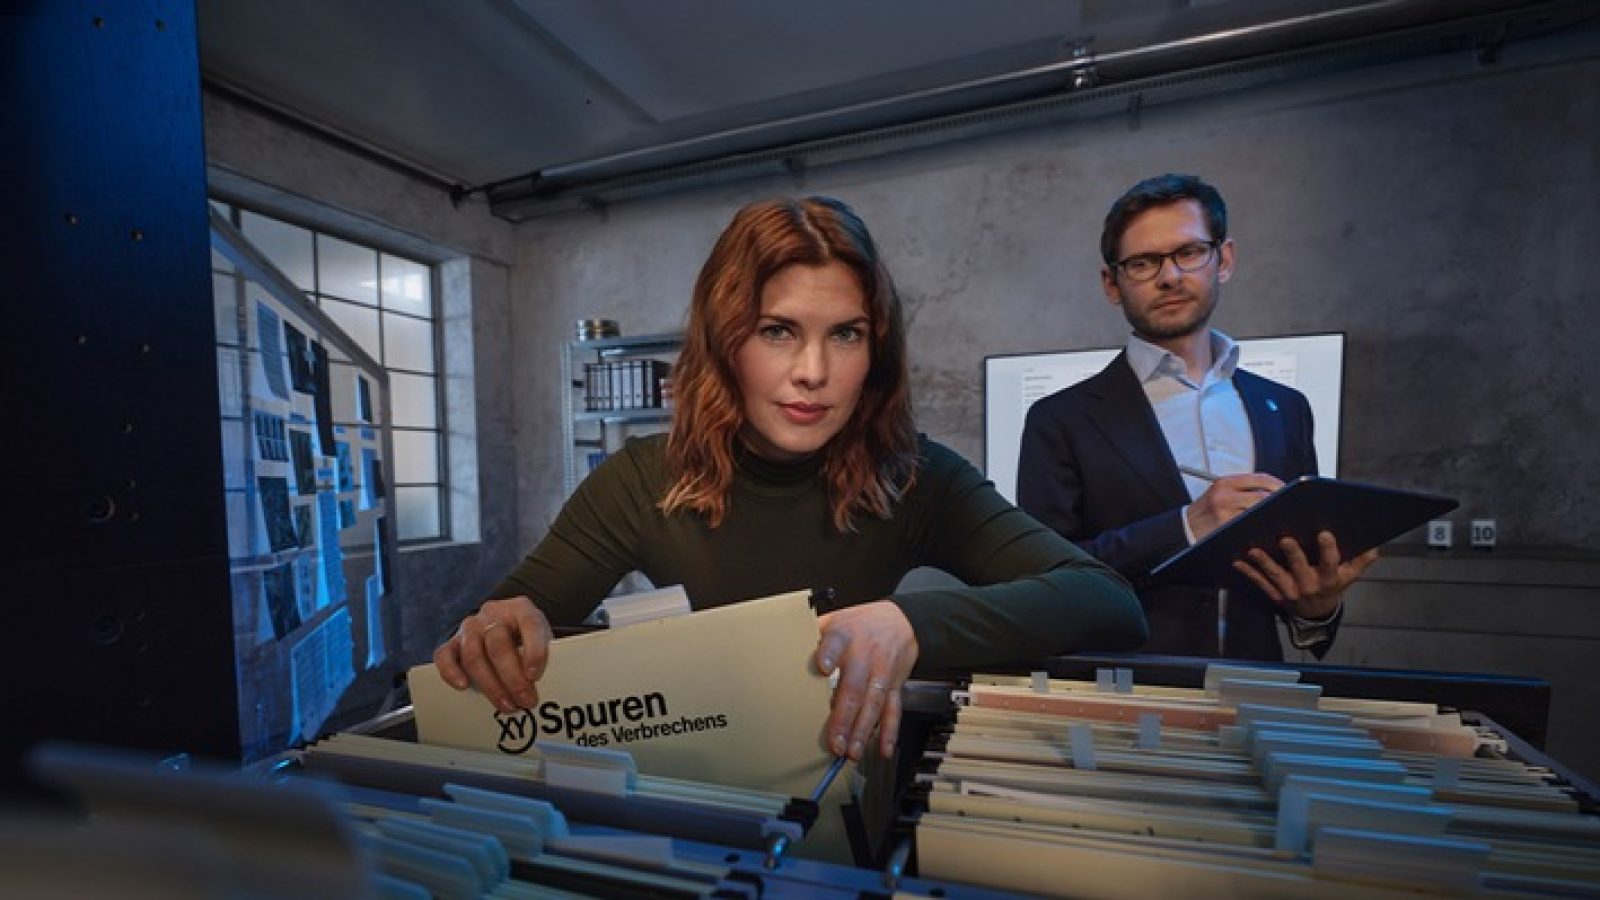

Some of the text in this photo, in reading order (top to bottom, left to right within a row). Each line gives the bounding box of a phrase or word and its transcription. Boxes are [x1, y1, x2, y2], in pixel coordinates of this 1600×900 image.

[1434, 526, 1445, 541] 8
[1475, 526, 1492, 541] 10
[500, 691, 668, 740] XY Spuren
[575, 713, 728, 748] des Verbrechens
